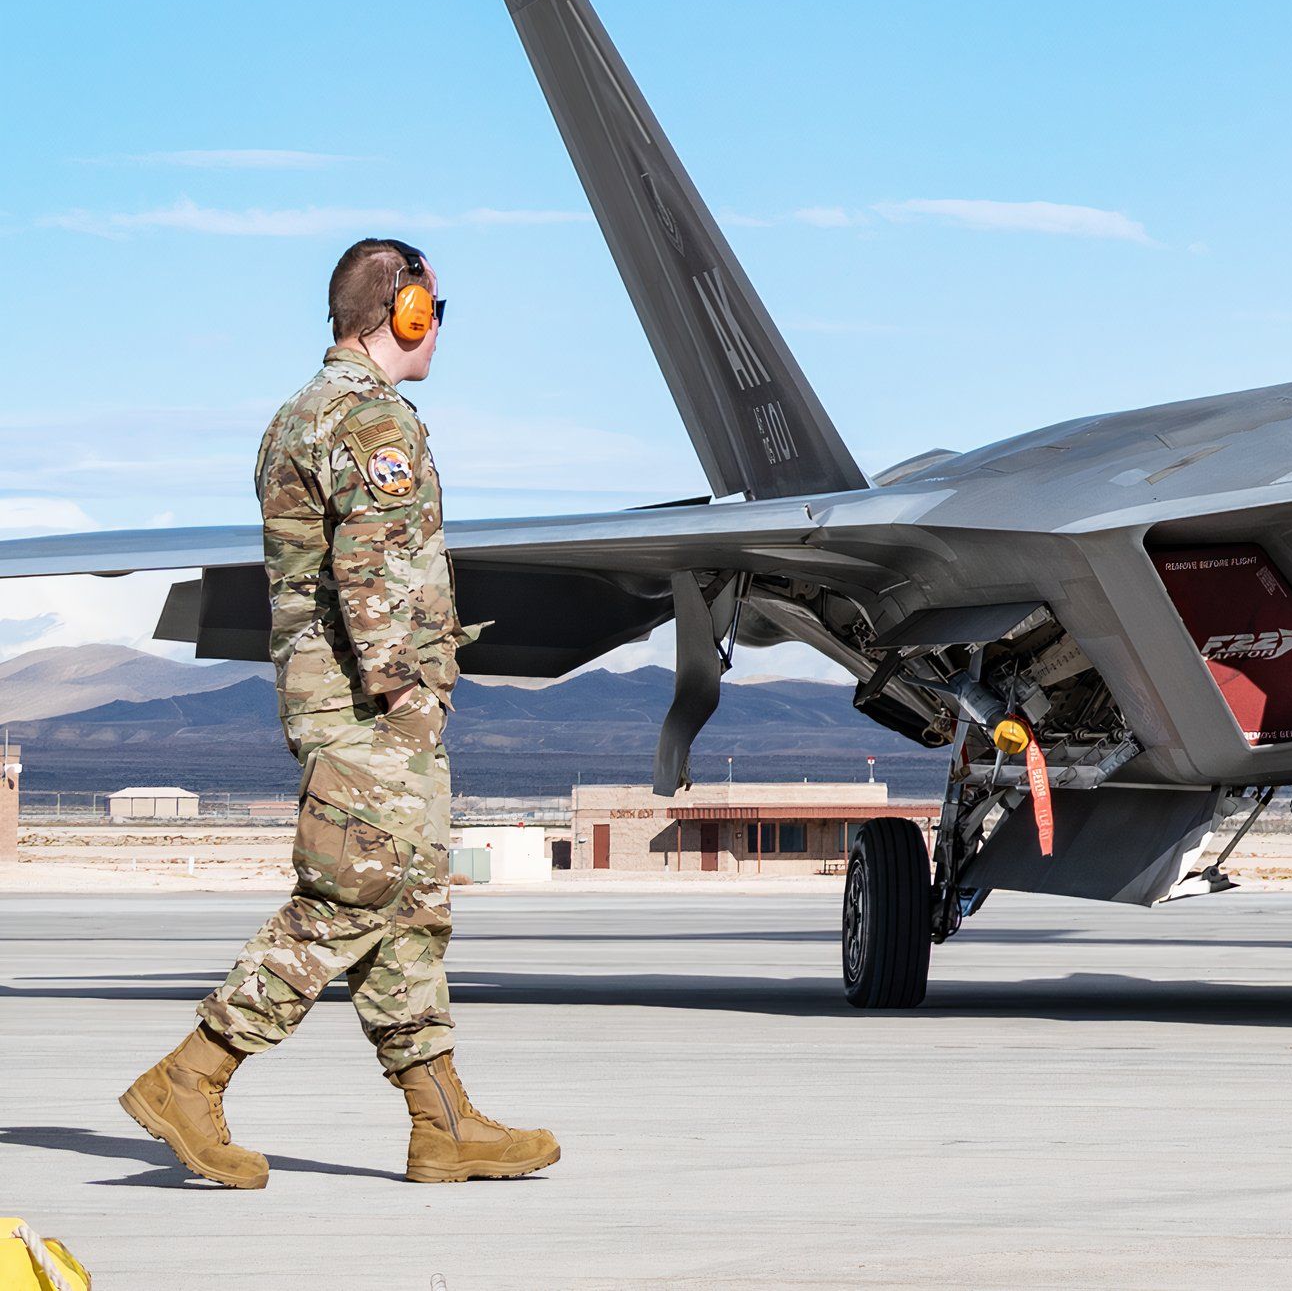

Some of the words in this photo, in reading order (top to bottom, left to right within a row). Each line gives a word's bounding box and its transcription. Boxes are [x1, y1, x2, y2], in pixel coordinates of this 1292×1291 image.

[692, 267, 771, 390] AK
[1165, 560, 1197, 571] REMOVE
[1200, 558, 1229, 569] BEFORE
